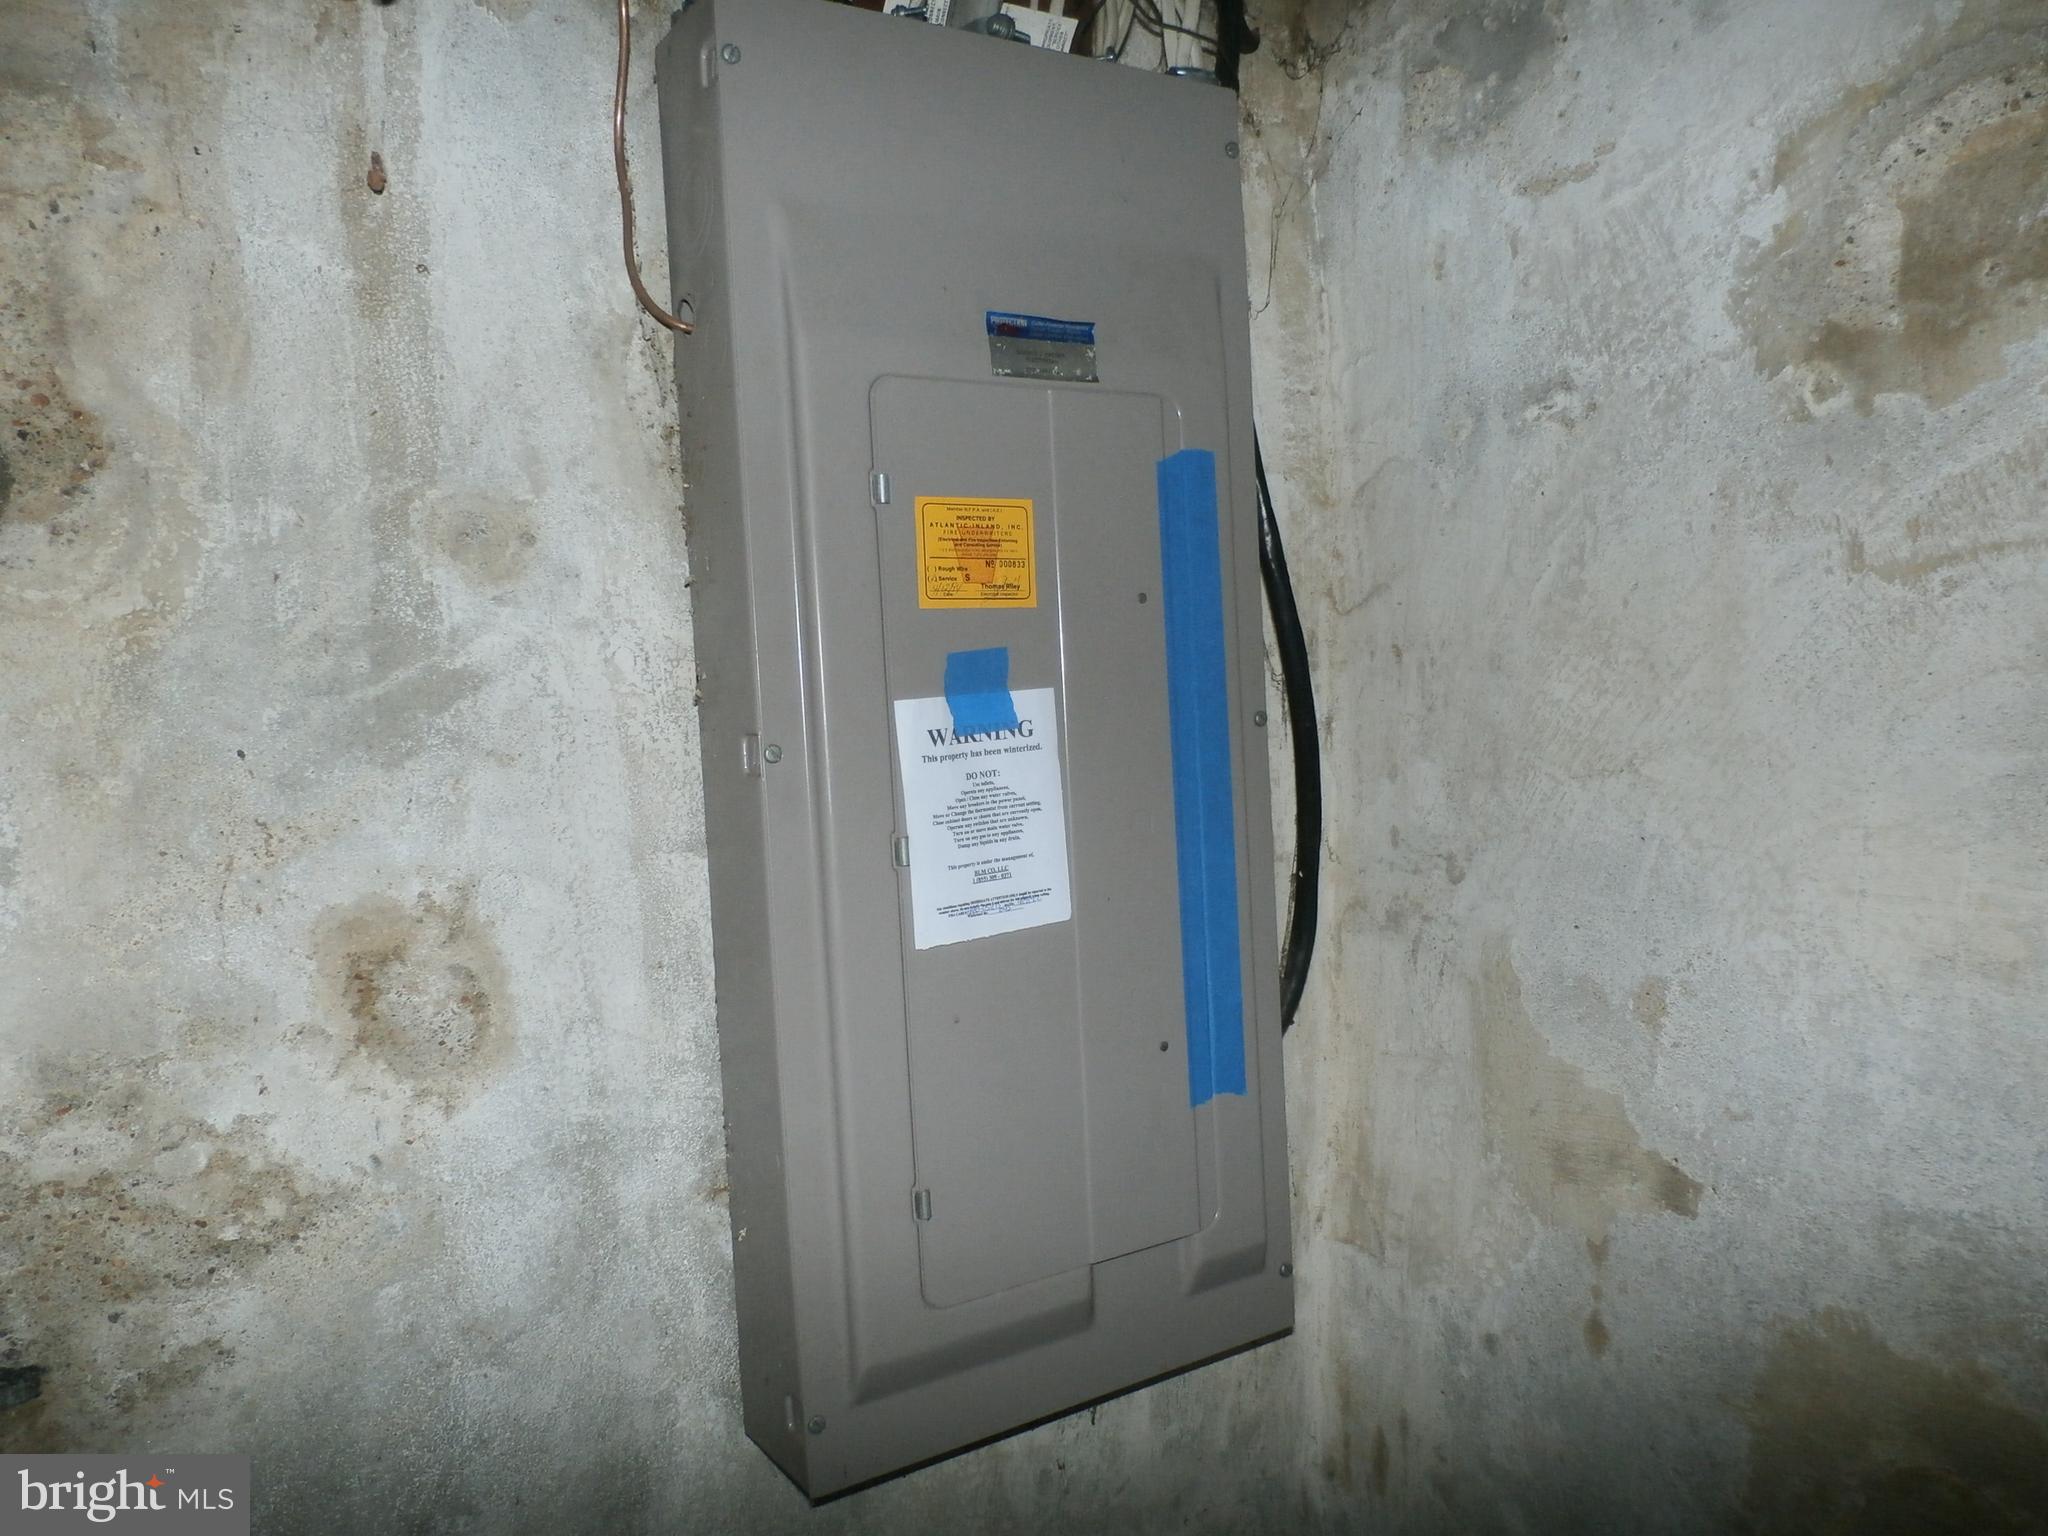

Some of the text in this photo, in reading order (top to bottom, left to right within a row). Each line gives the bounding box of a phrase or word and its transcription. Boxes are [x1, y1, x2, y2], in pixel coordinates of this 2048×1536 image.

[926, 719, 1034, 748] WARNING
[922, 742, 1043, 764] This property has been winterized.
[966, 769, 1001, 780] DO NOT:
